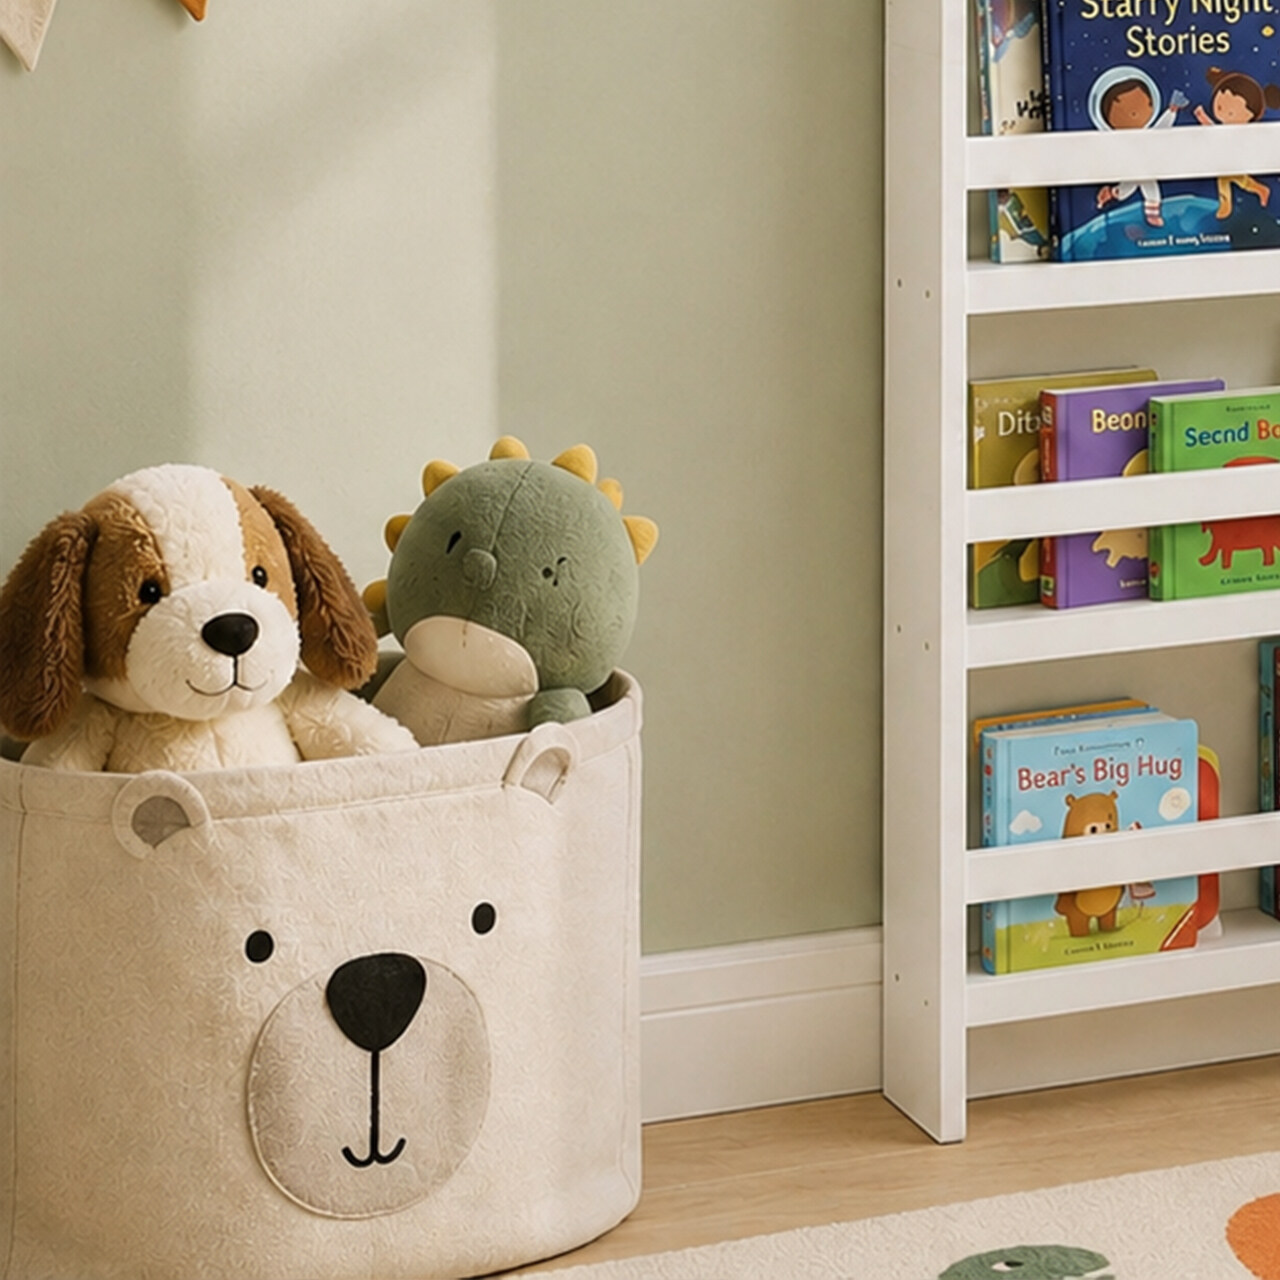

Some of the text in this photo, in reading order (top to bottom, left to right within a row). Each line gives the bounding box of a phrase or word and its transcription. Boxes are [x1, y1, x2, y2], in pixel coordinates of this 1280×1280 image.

[1126, 26, 1230, 58] Stories
[1185, 422, 1249, 448] Secnd
[1017, 755, 1182, 792] Bear's Big Hug
